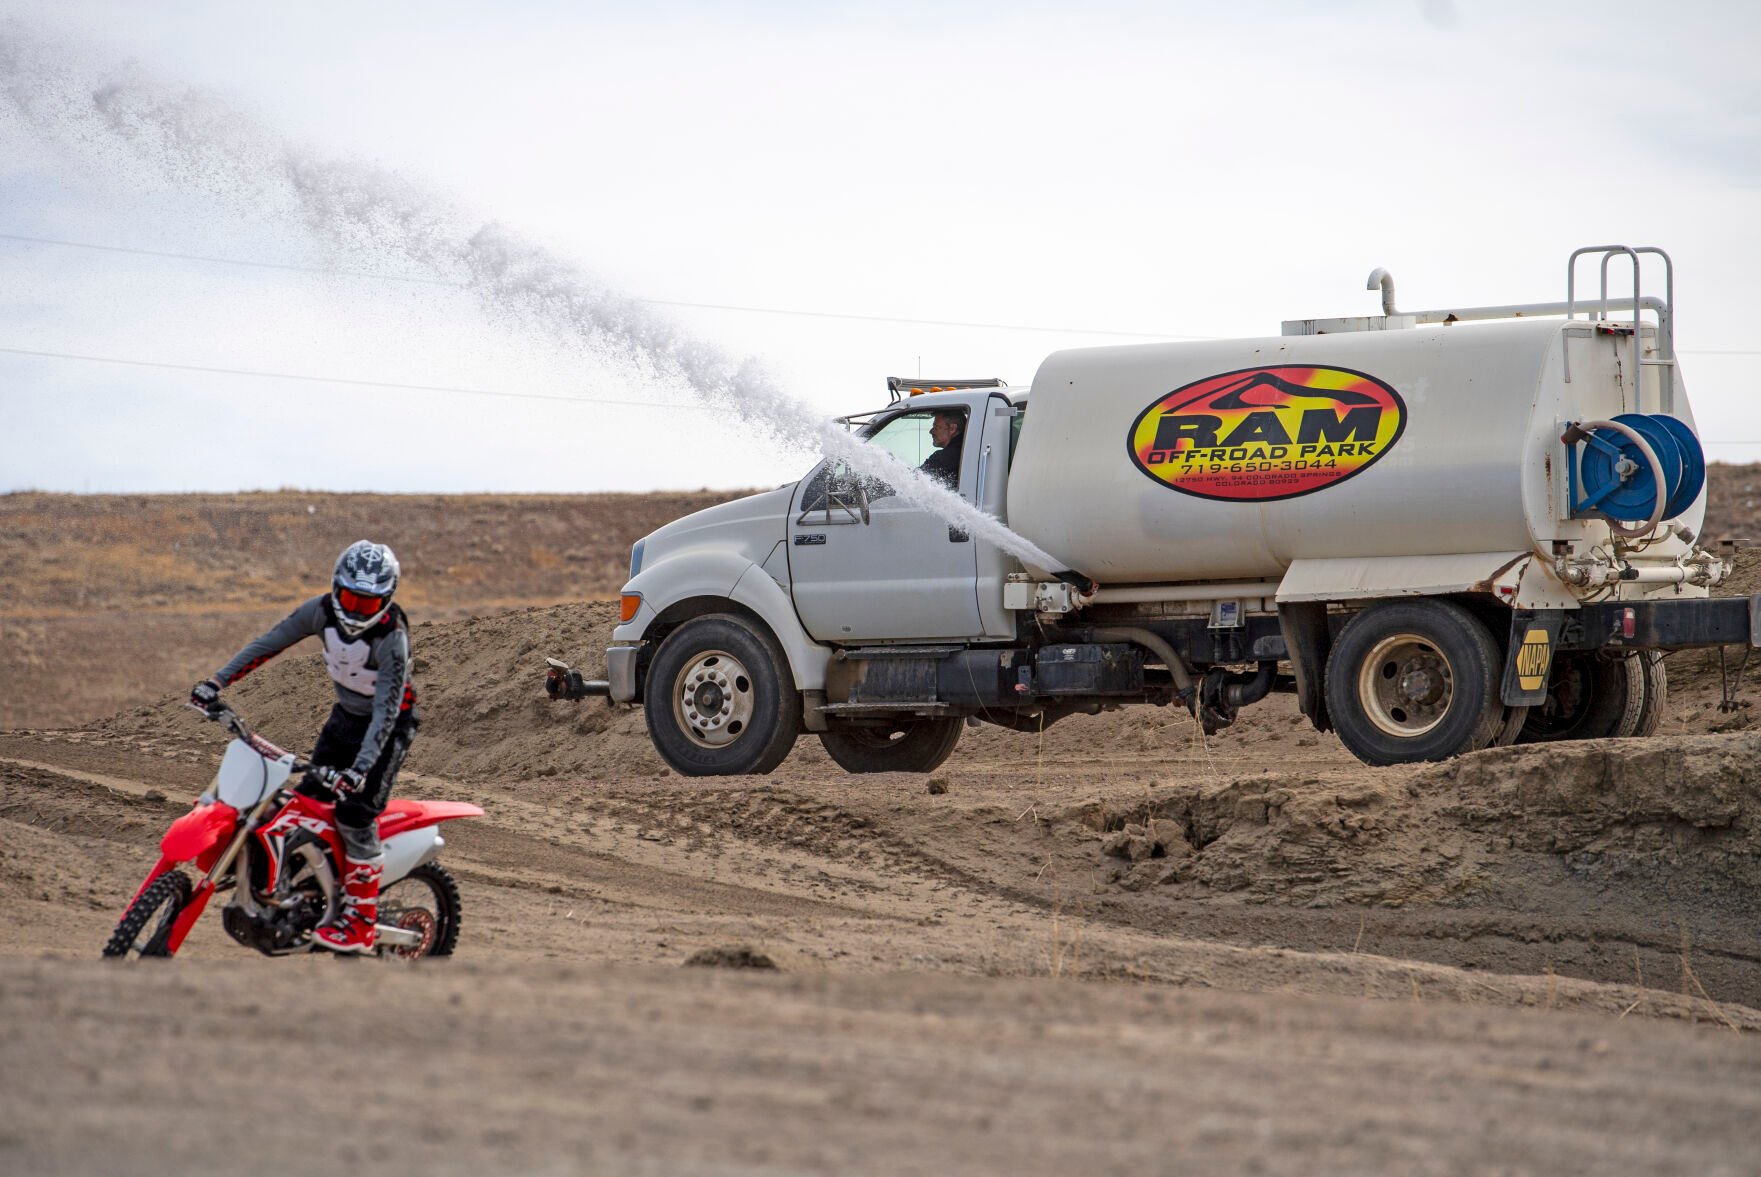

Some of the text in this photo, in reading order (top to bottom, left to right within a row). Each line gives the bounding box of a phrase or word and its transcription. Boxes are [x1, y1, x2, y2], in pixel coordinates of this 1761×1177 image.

[1152, 407, 1383, 451] RAM
[1147, 442, 1377, 465] OFF-ROAD PARK
[1181, 459, 1337, 474] 719-650-3044
[1215, 479, 1266, 487] COLORADO
[1246, 472, 1297, 481] COLORADO
[1520, 644, 1548, 676] NAPA
